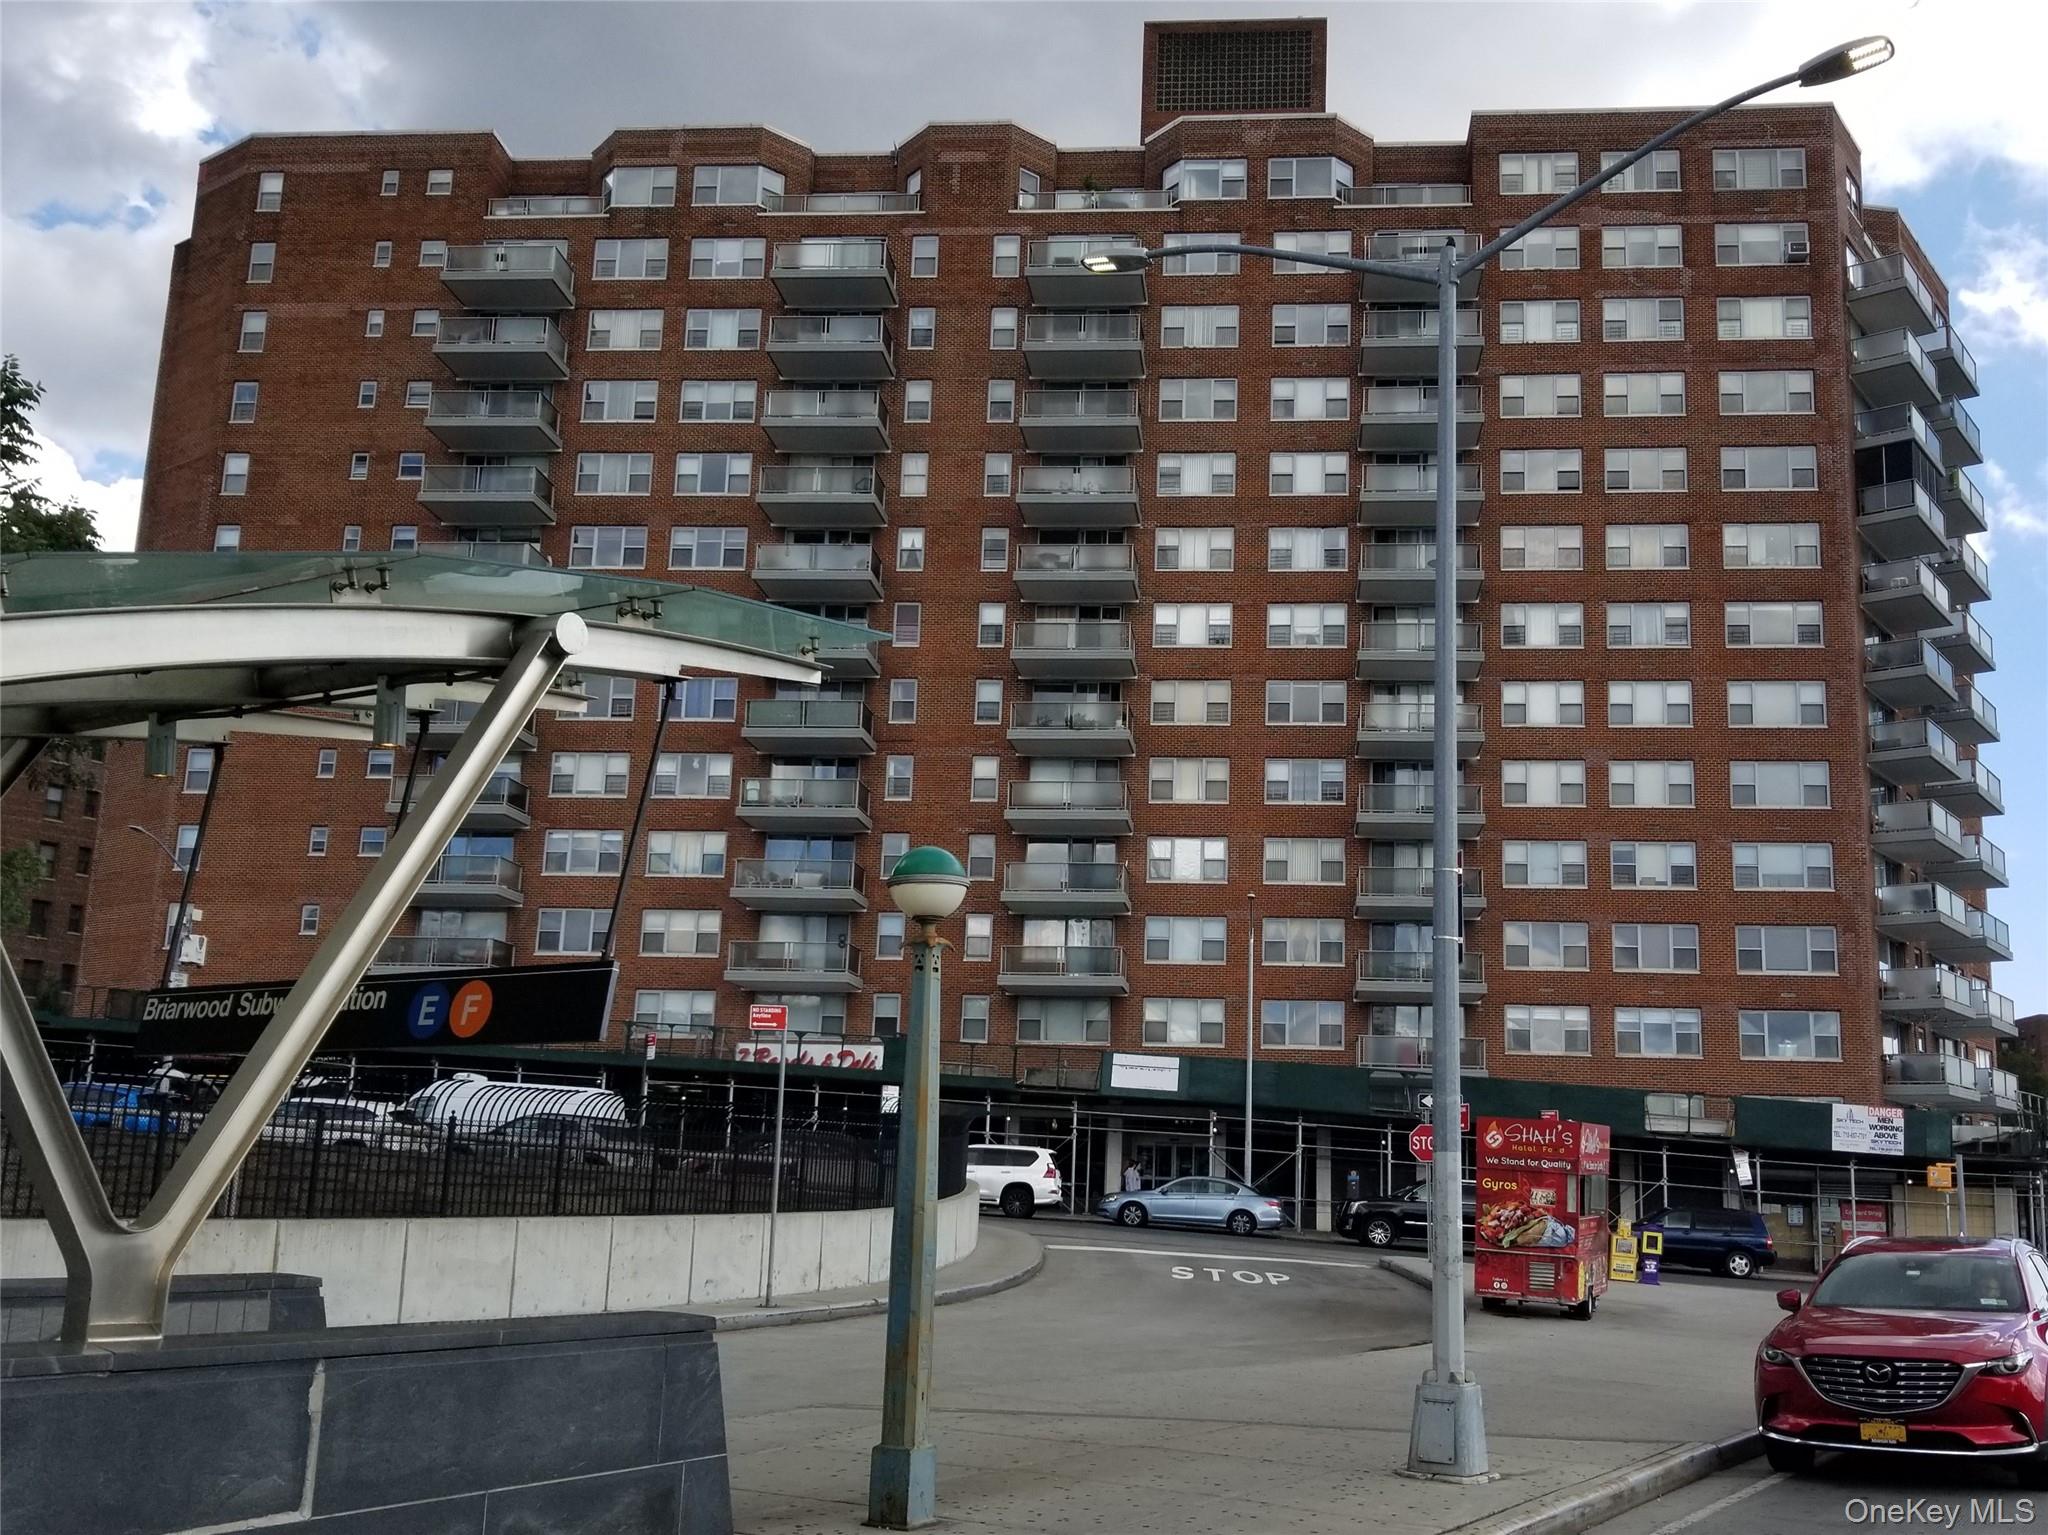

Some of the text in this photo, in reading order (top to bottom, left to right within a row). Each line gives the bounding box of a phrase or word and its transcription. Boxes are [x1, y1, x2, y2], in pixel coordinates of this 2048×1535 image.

[143, 986, 387, 1021] Briarwood Subw tion
[417, 994, 483, 1026] E F
[1869, 1107, 1903, 1118] DANGER
[1504, 1123, 1574, 1145] SHAH'S
[1869, 1124, 1903, 1132] WORKING
[1873, 1132, 1899, 1140] ABOVE
[1412, 1136, 1433, 1150] STO
[1542, 1146, 1565, 1154] Fod
[1485, 1156, 1571, 1169] We Stand for Quality
[1482, 1178, 1518, 1191] Gyros
[1171, 1266, 1290, 1285] STOP
